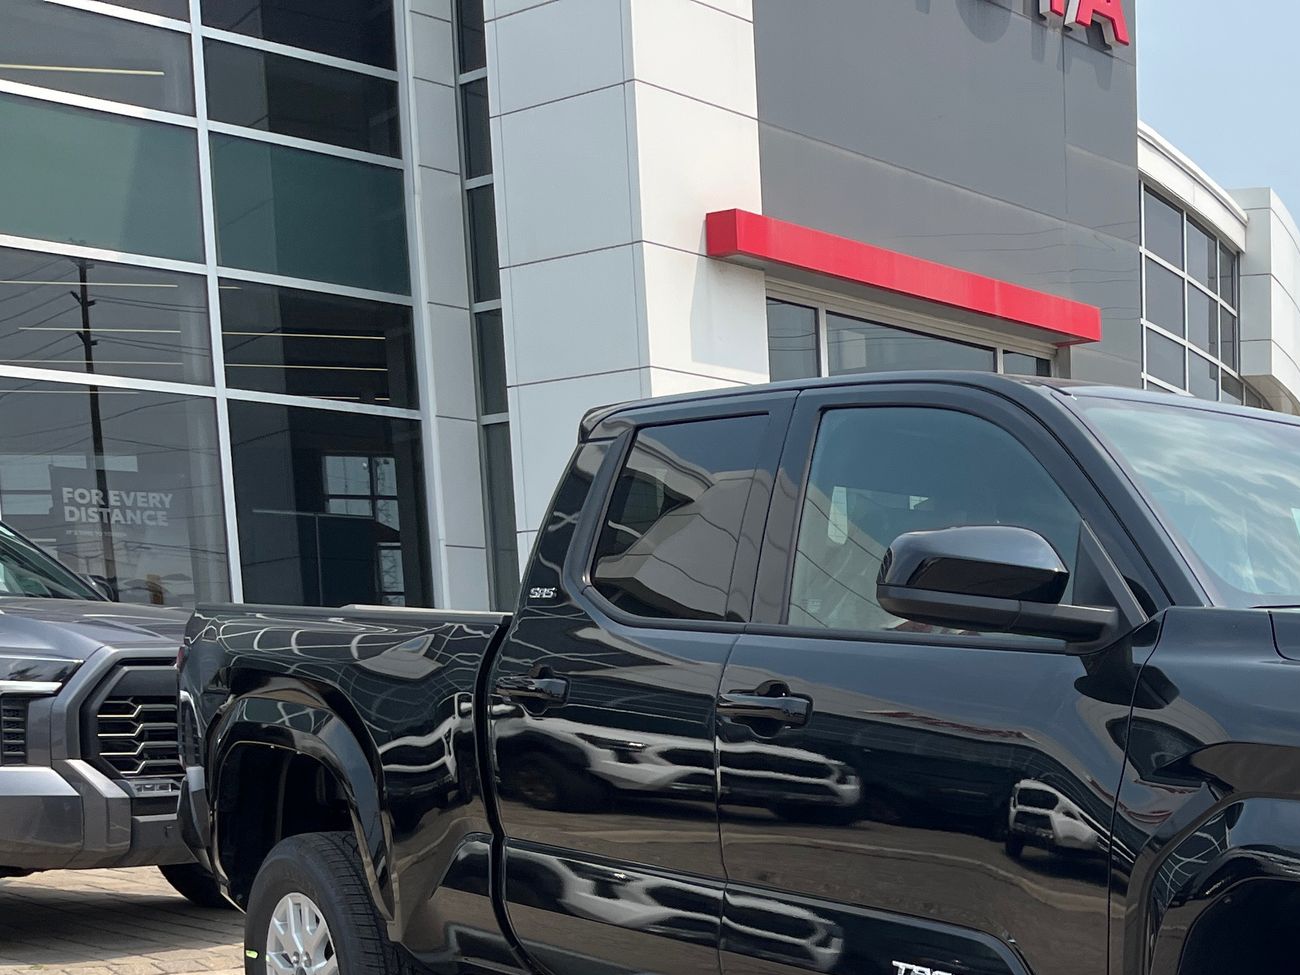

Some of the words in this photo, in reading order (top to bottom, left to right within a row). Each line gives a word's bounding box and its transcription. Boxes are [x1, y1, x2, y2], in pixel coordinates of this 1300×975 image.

[62, 487, 105, 505] FOR
[108, 490, 173, 509] EVERY
[64, 506, 169, 526] DISTANCE
